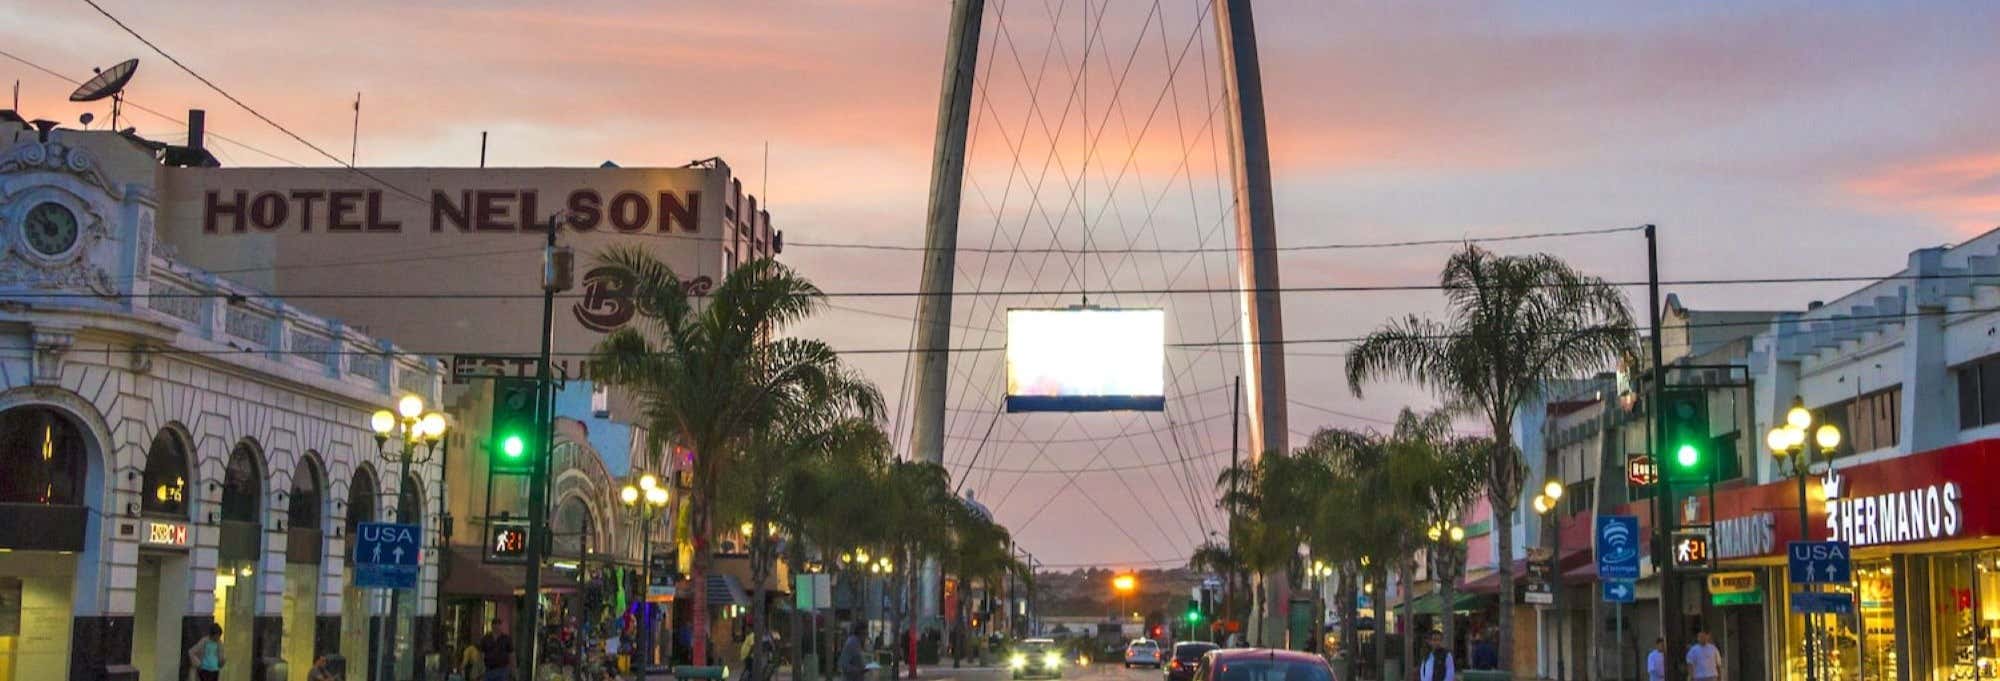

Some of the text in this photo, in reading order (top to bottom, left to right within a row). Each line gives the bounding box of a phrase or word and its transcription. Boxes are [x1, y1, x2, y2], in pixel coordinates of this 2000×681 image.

[203, 188, 700, 234] HOTEL NELSON
[1841, 482, 1957, 546] HERMANOS
[364, 526, 413, 544] USA
[507, 532, 522, 550] 21
[1690, 538, 1706, 560] 21
[1795, 545, 1845, 561] USA
